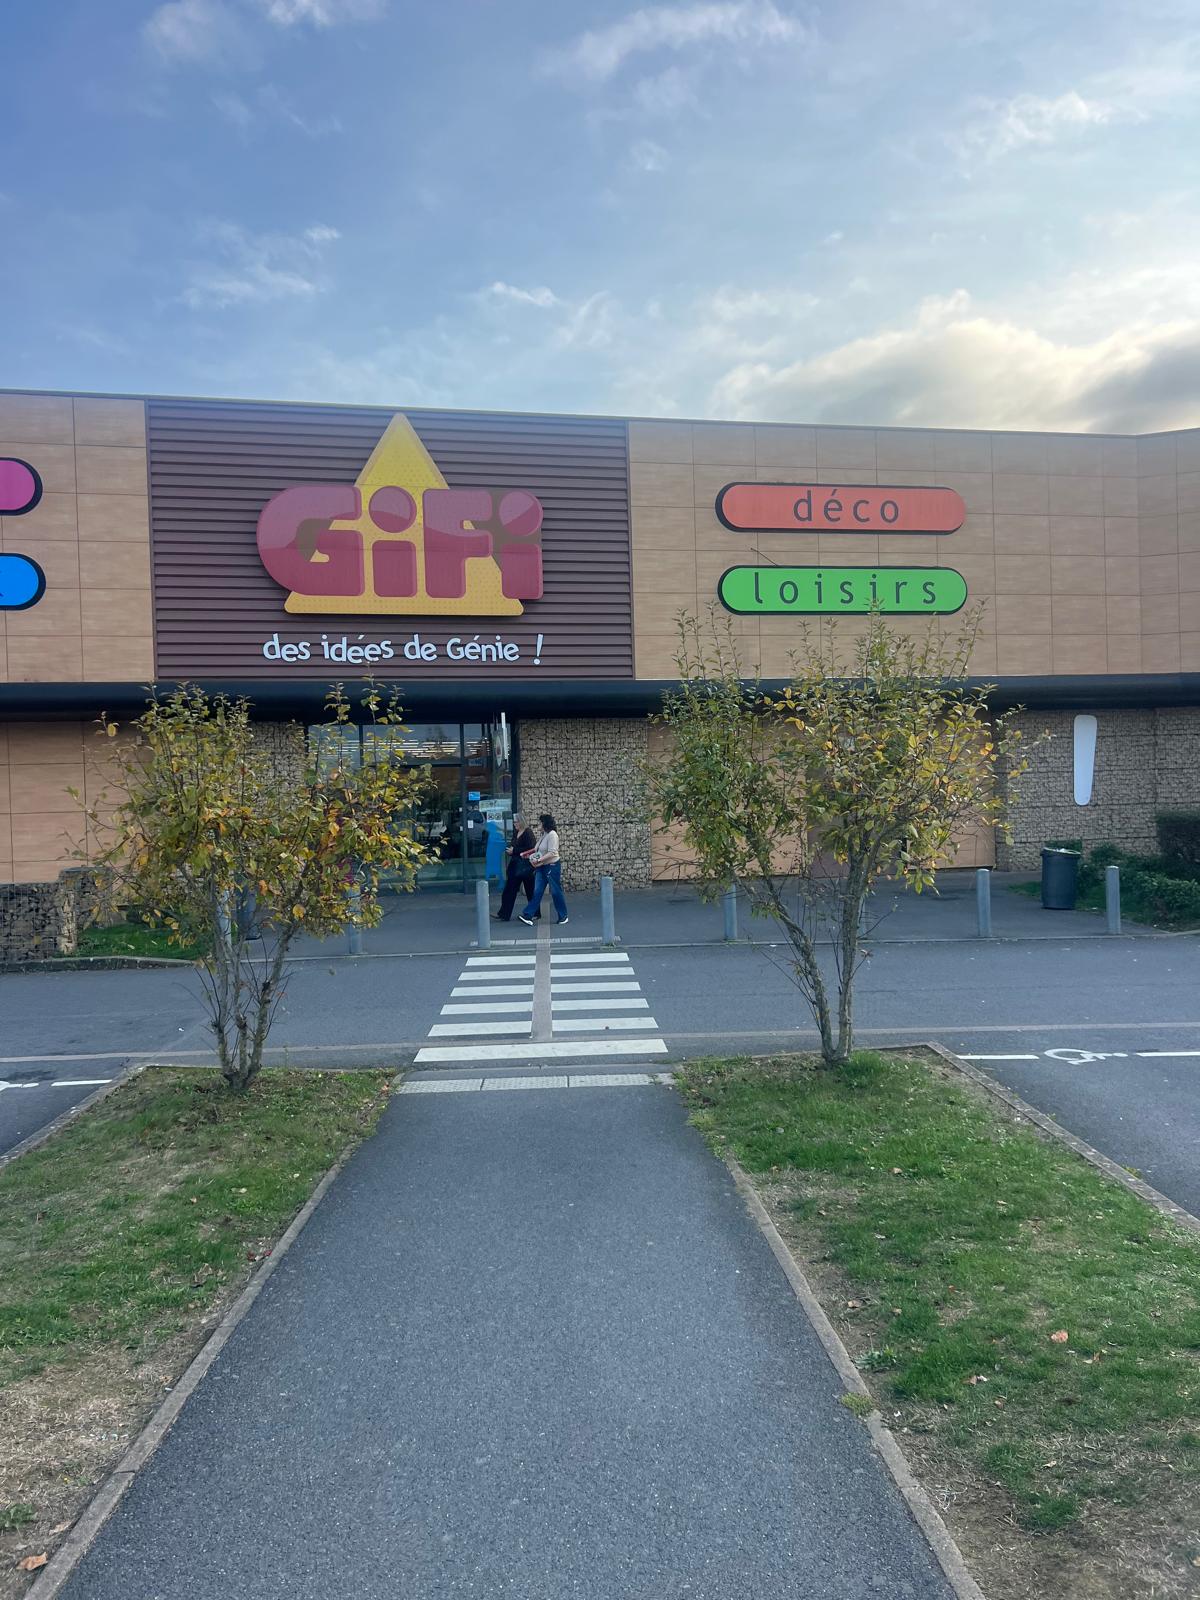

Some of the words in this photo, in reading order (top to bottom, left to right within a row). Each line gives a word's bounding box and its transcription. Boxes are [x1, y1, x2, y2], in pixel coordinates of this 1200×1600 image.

[793, 488, 899, 523] déco
[754, 571, 937, 604] loisirs
[263, 633, 311, 662] des
[321, 633, 394, 664] idées
[404, 633, 438, 661] de
[447, 635, 520, 662] Génie
